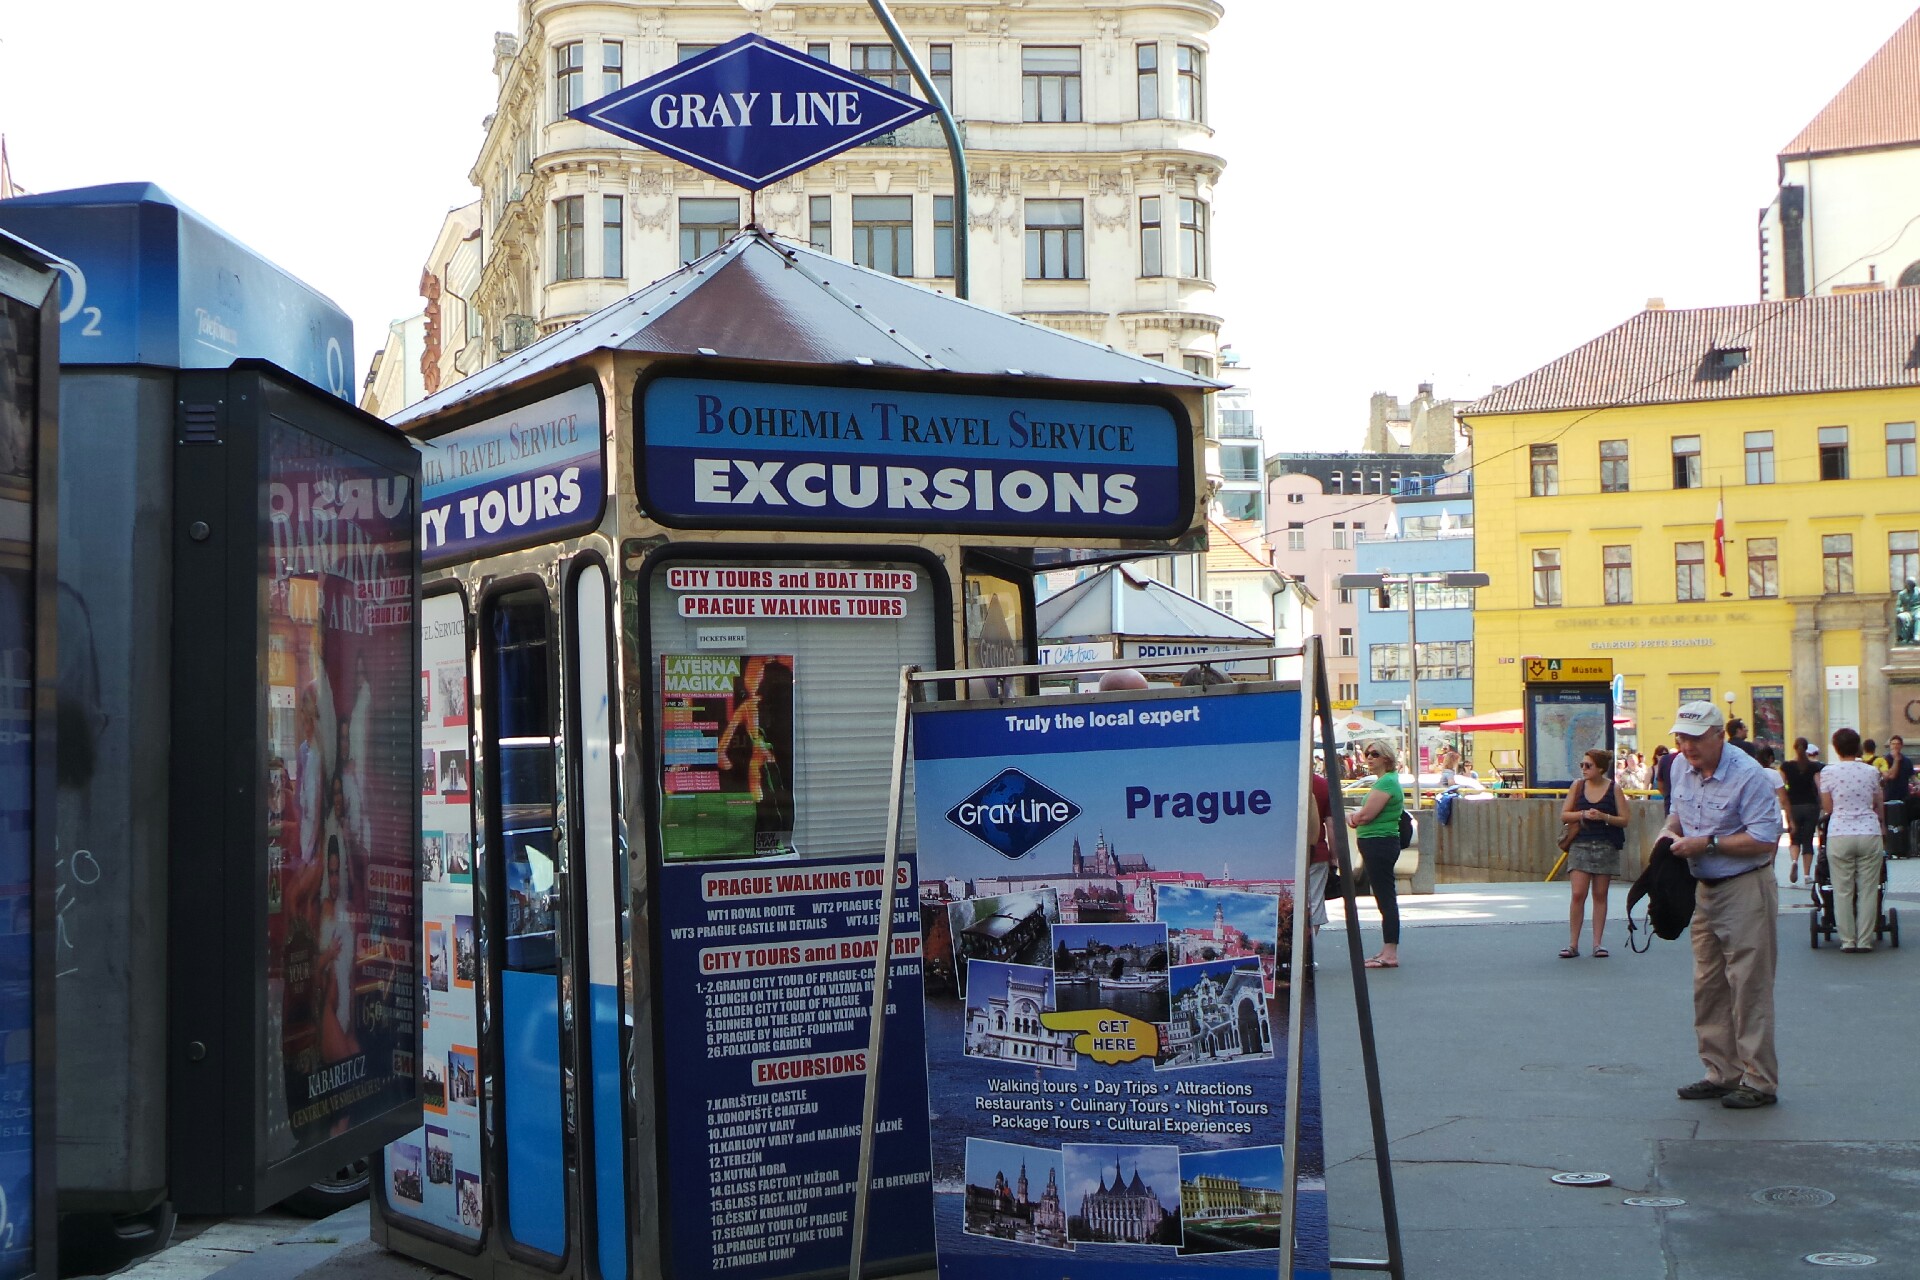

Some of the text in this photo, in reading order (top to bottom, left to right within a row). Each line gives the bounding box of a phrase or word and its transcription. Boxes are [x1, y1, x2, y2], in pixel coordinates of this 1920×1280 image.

[650, 91, 862, 130] GRAY LINE
[695, 394, 1135, 452] BOHEMIA TRAVEL SERVICE
[447, 413, 579, 480] TRAVEL SERVICE
[694, 458, 1139, 515] EXCURSIONS
[460, 467, 581, 540] TOURS
[670, 569, 912, 590] CITY TOURS and BOAT TRIPS
[684, 598, 902, 616] PRAGUE WALKING TOURS
[665, 659, 740, 675] LATERNA
[1550, 660, 1558, 669] A
[1552, 672, 1558, 680] B
[665, 675, 733, 691] MAGIKA
[1005, 706, 1200, 734] Truly the local expert
[958, 803, 1018, 826] Gray
[1125, 786, 1272, 824] Prague
[707, 868, 908, 897] PRAGUE WALKING TOUS
[707, 905, 795, 922] WT1 ROYAL ROUTE
[812, 897, 910, 914] WT2 PRAGUE CTLE
[671, 918, 827, 940] WT3 PRAGUE CASTLE IN DETAILS
[846, 911, 919, 927] WT4 JESH PR
[703, 951, 742, 971] CITY
[745, 946, 800, 967] TOURS
[804, 943, 836, 963] and
[891, 937, 920, 956] RIP
[696, 964, 920, 994] 1.-2.GRAND CITY TOUR OF PRAGUE-CAE AREA
[705, 980, 893, 1006] 3.LUNCH ON THE BOAT ON VLTAVA RIR
[705, 995, 860, 1019] 4.GOLDEN CITY TOUR OF PRAGUE
[706, 1006, 867, 1032] 5.DINNER ON THE BOAT ON VLTAVA
[1098, 1021, 1129, 1033] GET
[707, 1021, 855, 1046] 6.PRAGUE BY NIGHT- FOUNTAIN
[1093, 1038, 1136, 1051] HERE
[707, 1038, 812, 1058] 26.FOLKLORE GARDEN
[308, 1054, 366, 1099] KABARET.CZ
[757, 1053, 866, 1082] EXCURSIONS
[771, 1089, 807, 1103] CASTLE
[987, 1079, 1253, 1097] Walking tours Day Trips Attractions
[774, 1102, 818, 1117] CHATEAU
[975, 1097, 1268, 1116] Restaurants Culinary Tours Night Tours
[708, 1119, 796, 1140] 10.KARLOVY VARY
[992, 1116, 1251, 1134] Package Tours Cultural Experiences
[708, 1137, 766, 1154] 11.KARLOVY
[768, 1134, 793, 1147] VARY
[796, 1131, 815, 1144] and
[817, 1124, 863, 1141] MARIÁNS
[708, 1151, 763, 1169] 12.TEREZÍN
[709, 1163, 786, 1183] 13.KUTNÁ HORA
[710, 1180, 756, 1197] 14.GLASS
[758, 1174, 802, 1191] FACTORY
[710, 1171, 930, 1212] 15.GLASS FACT. and BREWERY
[759, 1202, 808, 1219] KRUMLOV
[711, 1211, 848, 1240] 17.SEGWAY TOUR OF PRAGUE
[712, 1226, 843, 1255] 18.PRAGUE CITY BIKE TOUR
[712, 1247, 796, 1270] 27.TANDEM JUMP
